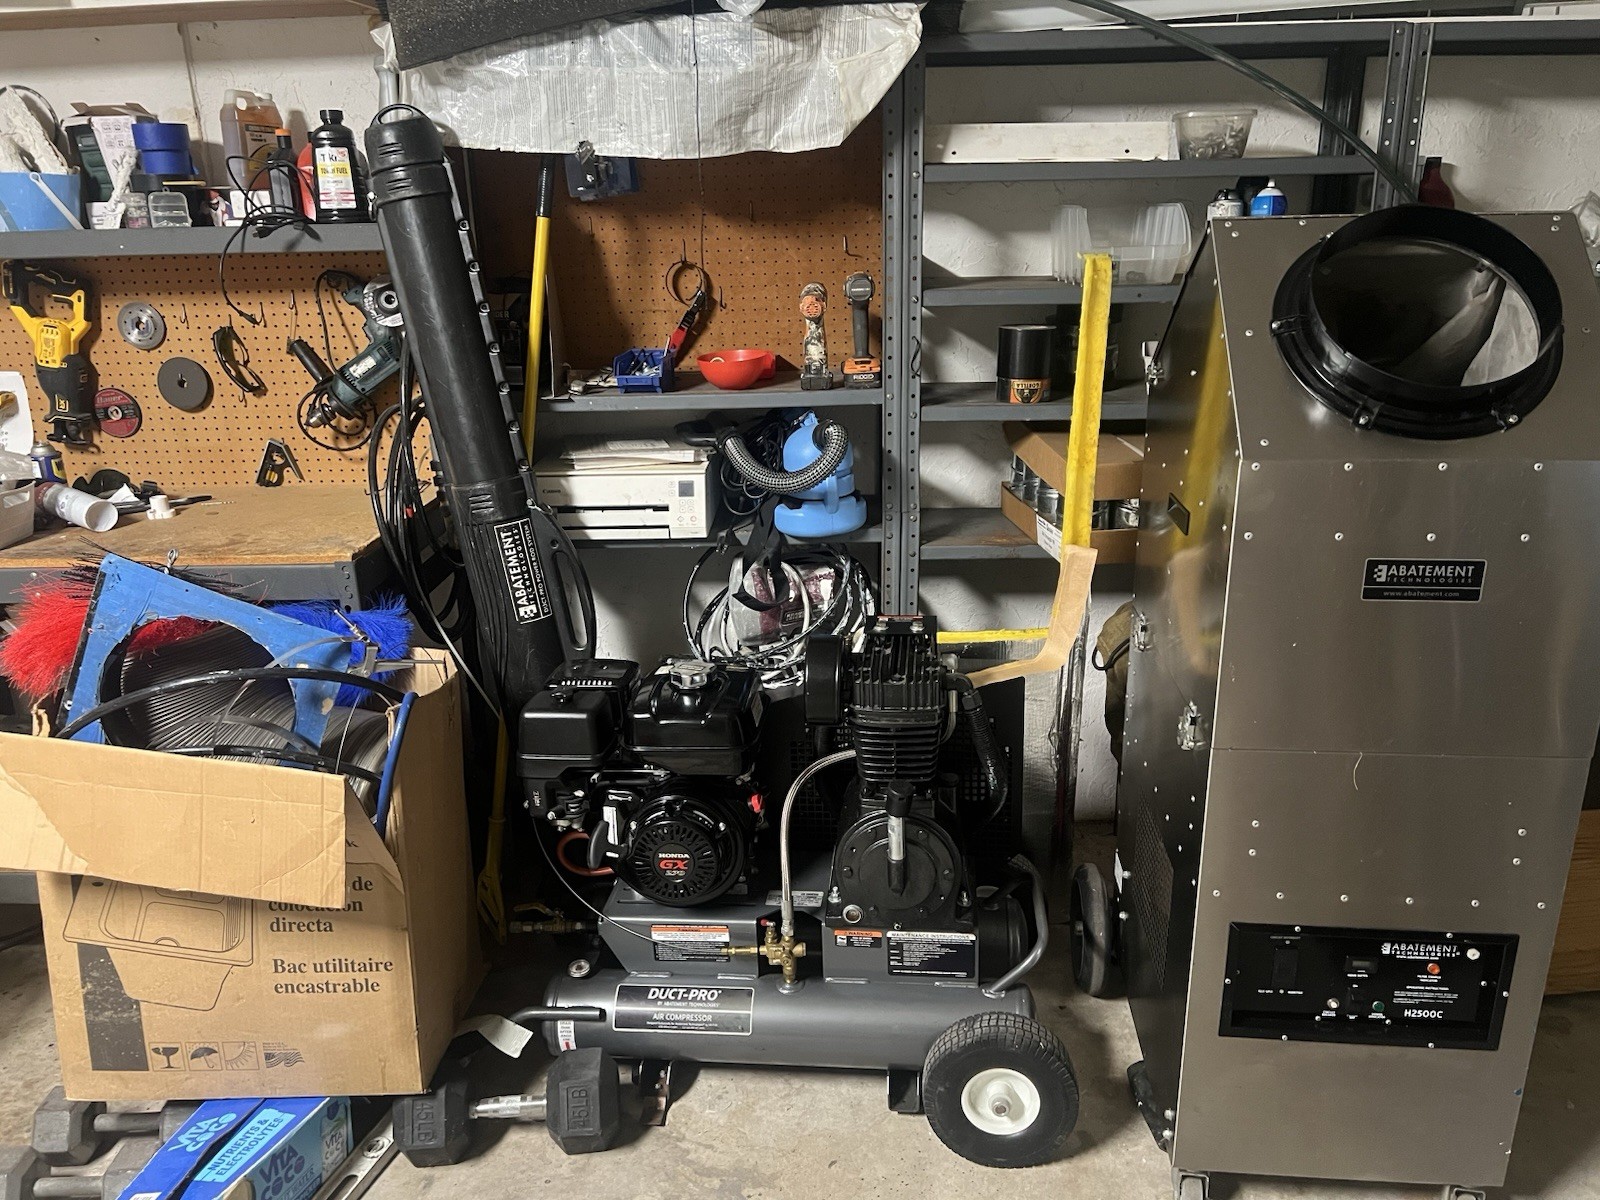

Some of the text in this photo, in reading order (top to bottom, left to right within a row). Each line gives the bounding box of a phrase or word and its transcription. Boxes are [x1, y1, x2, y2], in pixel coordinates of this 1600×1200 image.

[321, 152, 337, 162] Tki
[524, 524, 534, 547] SYSTEM
[500, 530, 530, 606] ABATEMENT
[512, 528, 535, 605] TECHNOLOGIES
[1388, 565, 1475, 577] ABATEMENT
[659, 860, 690, 869] GX
[352, 876, 373, 891] de
[269, 917, 334, 932] directa
[1392, 943, 1458, 952] ABATEMENT
[272, 958, 394, 973] Bac utilitaire
[274, 978, 380, 994] encastrable
[647, 988, 720, 1001] DUCT-PRO
[665, 1013, 713, 1022] COMPRESSOR
[1404, 1009, 1444, 1019] H2500C
[168, 1116, 220, 1152] VITA
[185, 1113, 237, 1152] COCO
[208, 1118, 269, 1171] NUTRIENTS &
[217, 1117, 284, 1176] ELECTROLYTES
[259, 1144, 299, 1184] VITA
[261, 1155, 305, 1200] COCO
